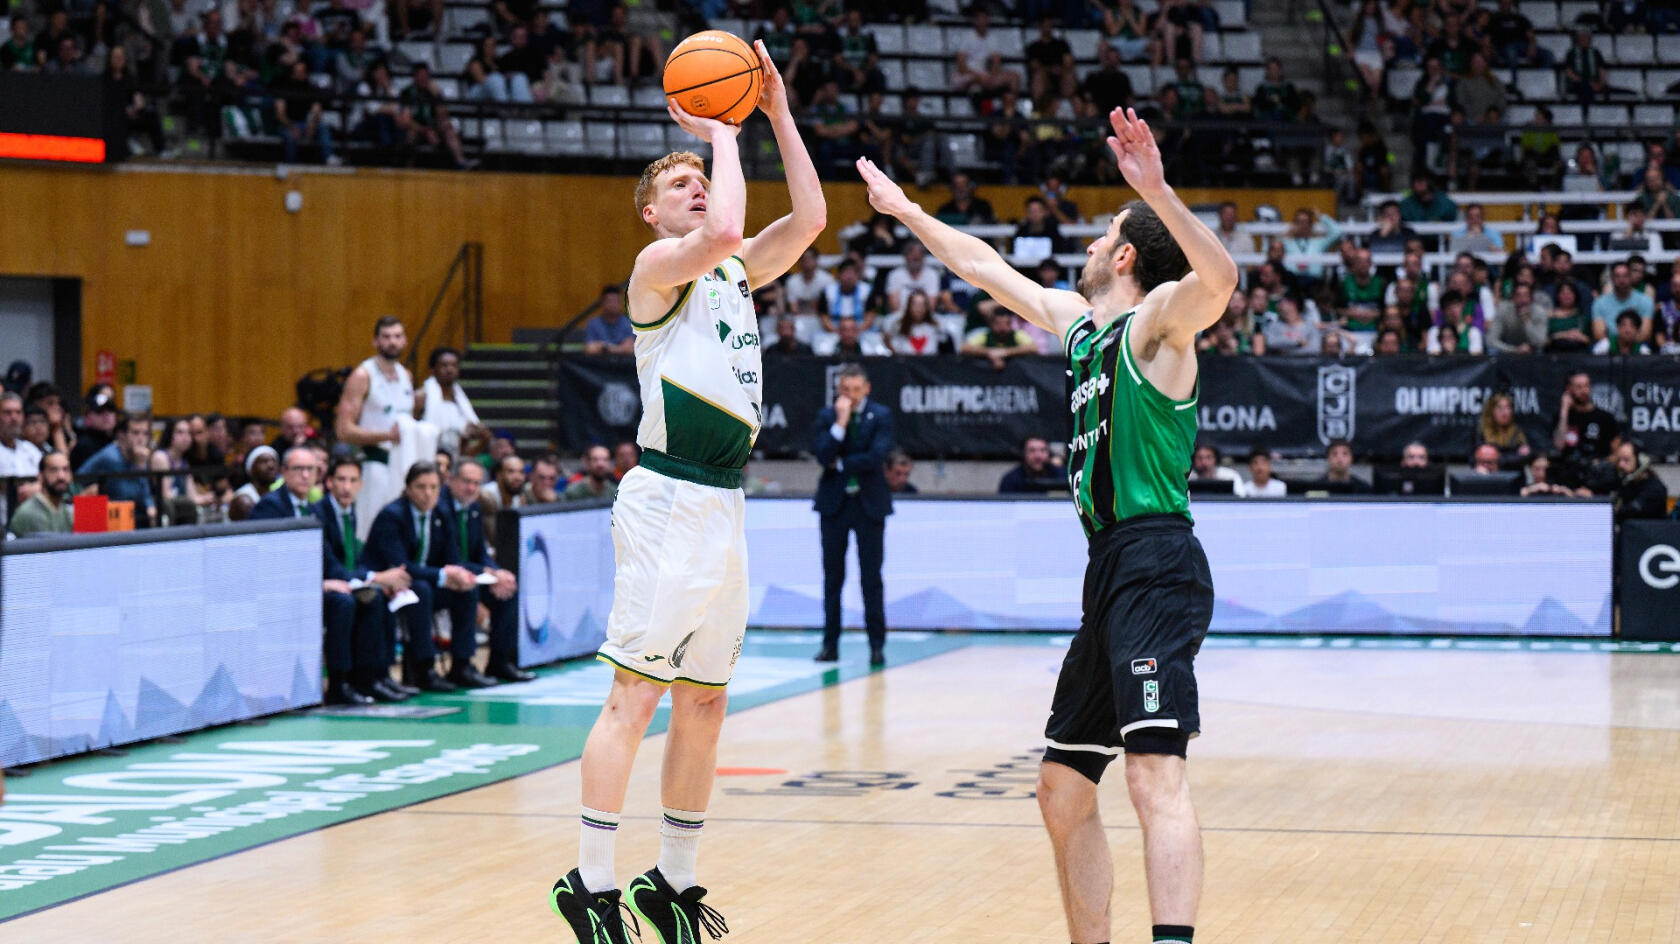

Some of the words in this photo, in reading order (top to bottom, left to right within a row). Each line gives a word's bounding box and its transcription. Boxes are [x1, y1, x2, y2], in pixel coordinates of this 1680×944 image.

[1631, 382, 1673, 407] City
[1196, 405, 1276, 431] LONA
[1134, 664, 1152, 672] acb
